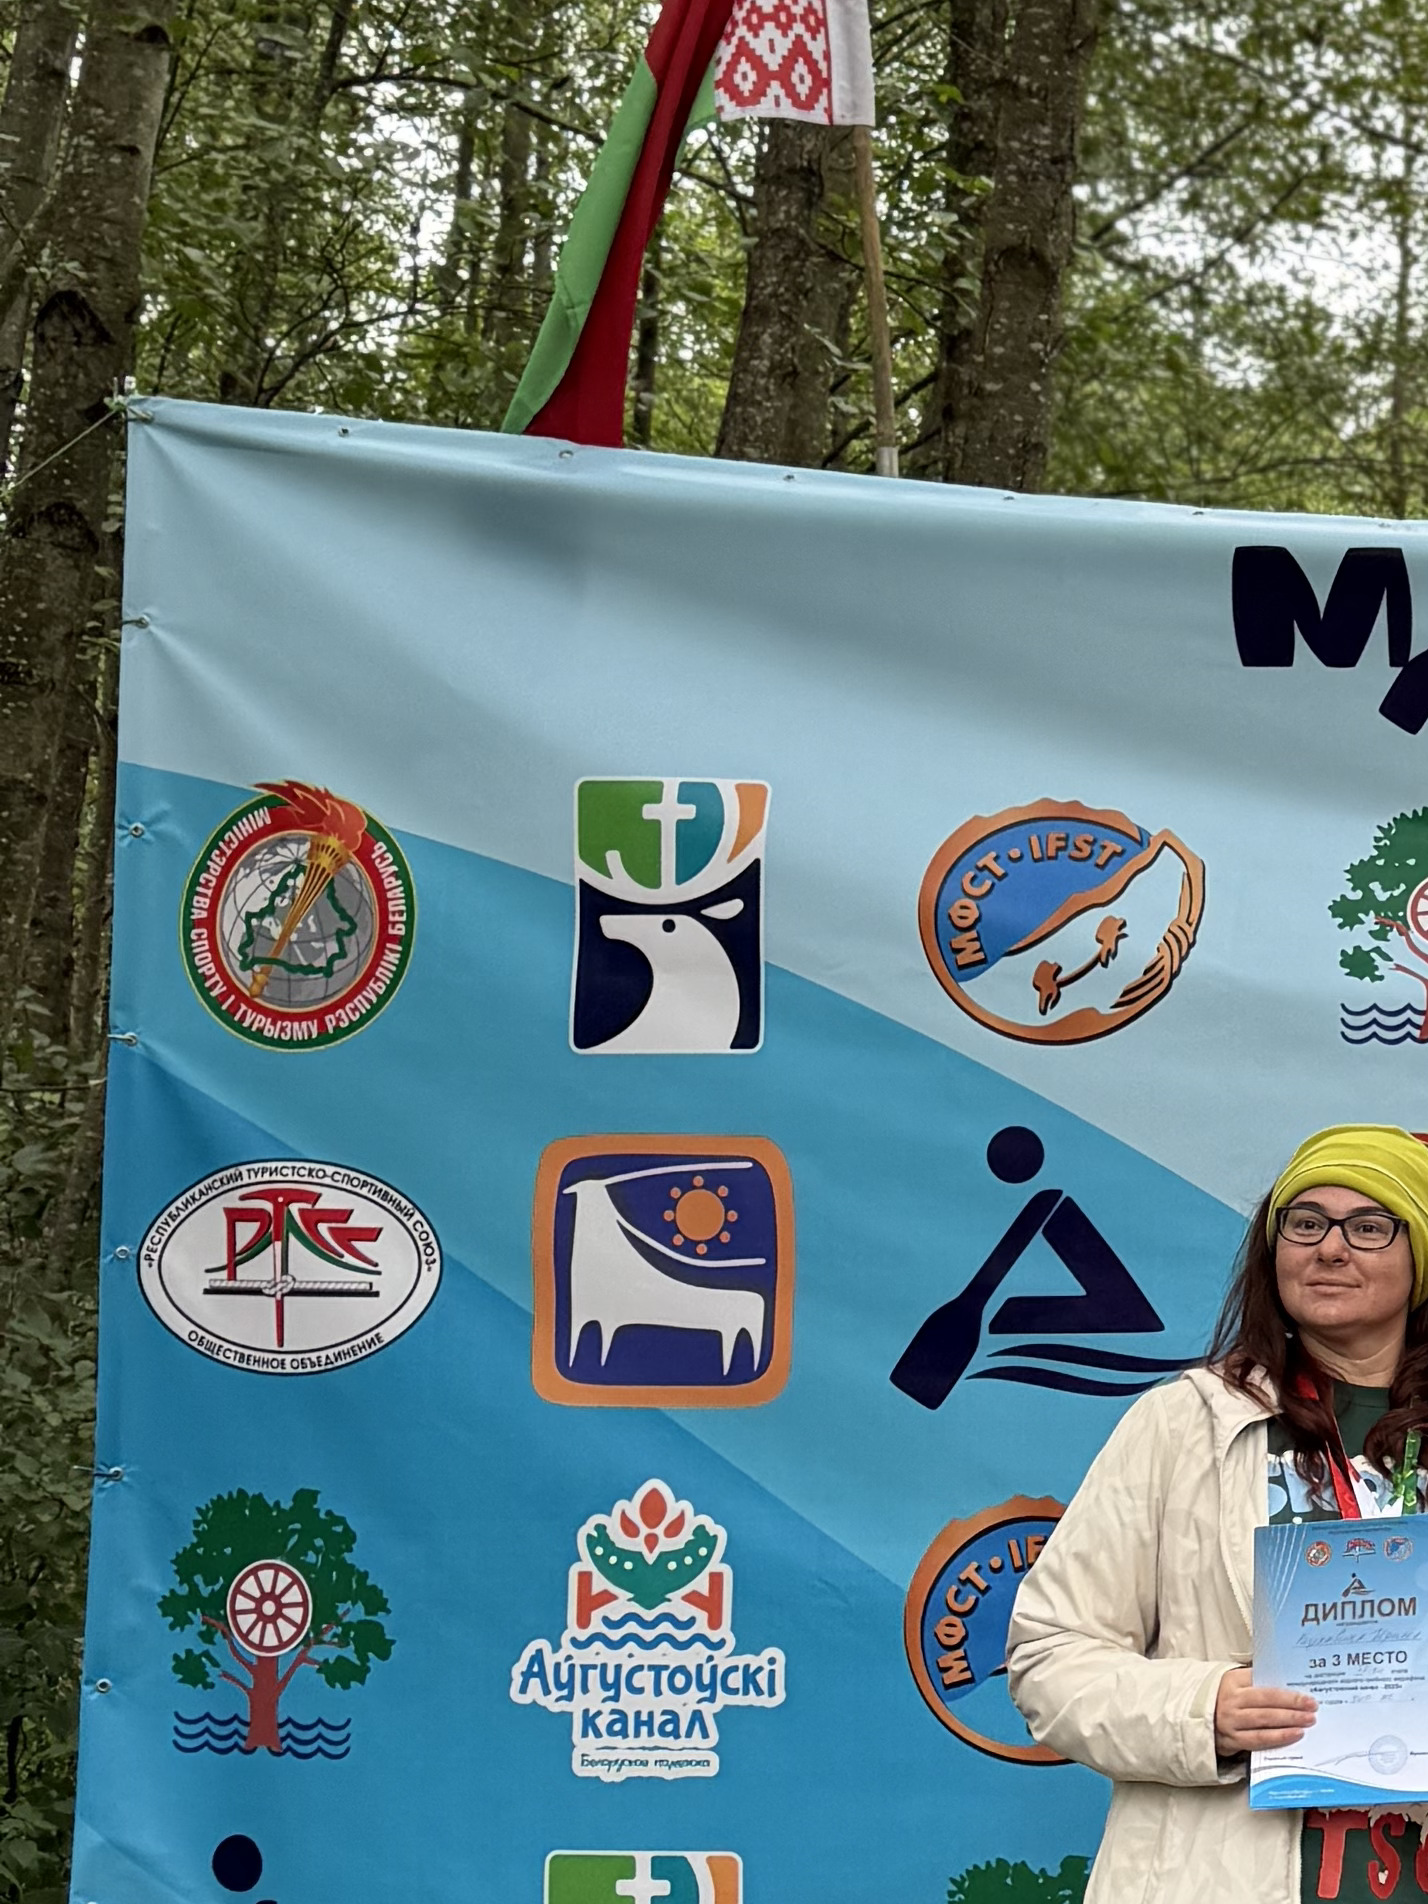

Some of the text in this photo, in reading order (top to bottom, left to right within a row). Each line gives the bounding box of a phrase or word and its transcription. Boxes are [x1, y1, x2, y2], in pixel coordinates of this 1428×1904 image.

[1029, 833, 1123, 870] IFST
[190, 927, 228, 998] СПОРТУ
[233, 1003, 319, 1042] ТУРЫЗМУ
[326, 942, 403, 1035] РЭСПУБЛІКІ
[373, 840, 406, 936] БЕЛАРУСЬ
[247, 1165, 416, 1222] ТУРИСТСКО-СПОРТИВНЫЙ
[187, 1330, 385, 1370] ОБЩЕСТВЕННОЕ ОБЪЕДИНЕНИЕ
[1301, 1597, 1417, 1627] ДИПЛОМ
[519, 1648, 777, 1704] Аўгустоўскі
[1308, 1650, 1408, 1669] за 3 МЕСТО
[581, 1708, 710, 1740] канал
